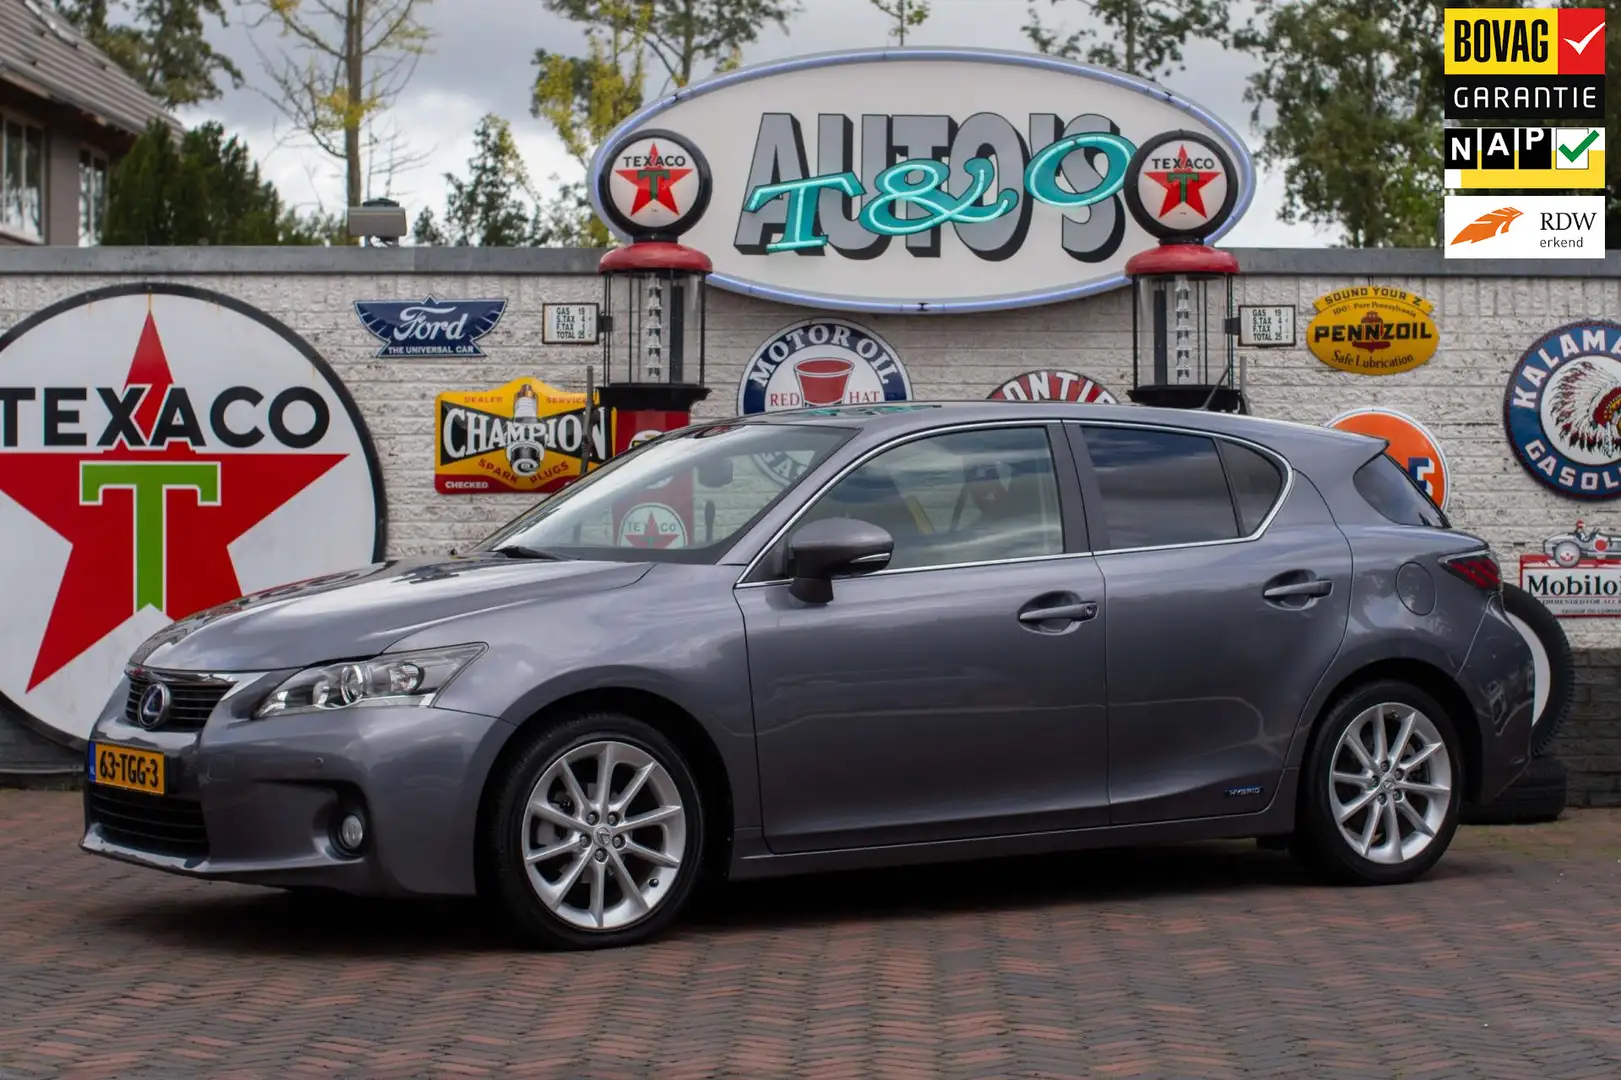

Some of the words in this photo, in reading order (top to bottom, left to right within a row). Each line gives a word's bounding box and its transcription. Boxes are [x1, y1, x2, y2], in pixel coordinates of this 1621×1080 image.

[623, 156, 686, 168] TEXACO
[1152, 158, 1214, 169] TEXACO
[1325, 287, 1369, 305] SOUND
[1373, 287, 1407, 301] YOUR
[1413, 296, 1422, 306] Z
[556, 307, 570, 315] GAS
[1252, 309, 1266, 317] GAS
[393, 306, 467, 340] Ford
[1313, 322, 1433, 343] PENNZOIL
[556, 331, 576, 339] TOTAL
[1252, 333, 1273, 341] TOTAL
[1274, 333, 1283, 341] 25
[405, 345, 454, 354] UNIVERSAL
[455, 345, 474, 354] CAR
[750, 324, 850, 387] MOTOR
[856, 338, 899, 385] OIL
[1331, 349, 1354, 365] Safe
[1355, 353, 1414, 369] Lubrication
[770, 393, 800, 407] RED
[849, 391, 880, 404] HAT
[0, 386, 330, 448] TEXACO
[478, 459, 519, 484] SPARK
[530, 461, 569, 485] PLUGS
[1524, 438, 1621, 491] GASOL
[445, 480, 488, 489] CHECKED
[626, 522, 676, 532] TECO
[79, 461, 221, 613] T
[1527, 575, 1621, 596] Mobilo
[100, 750, 159, 788] 63-TGG-3
